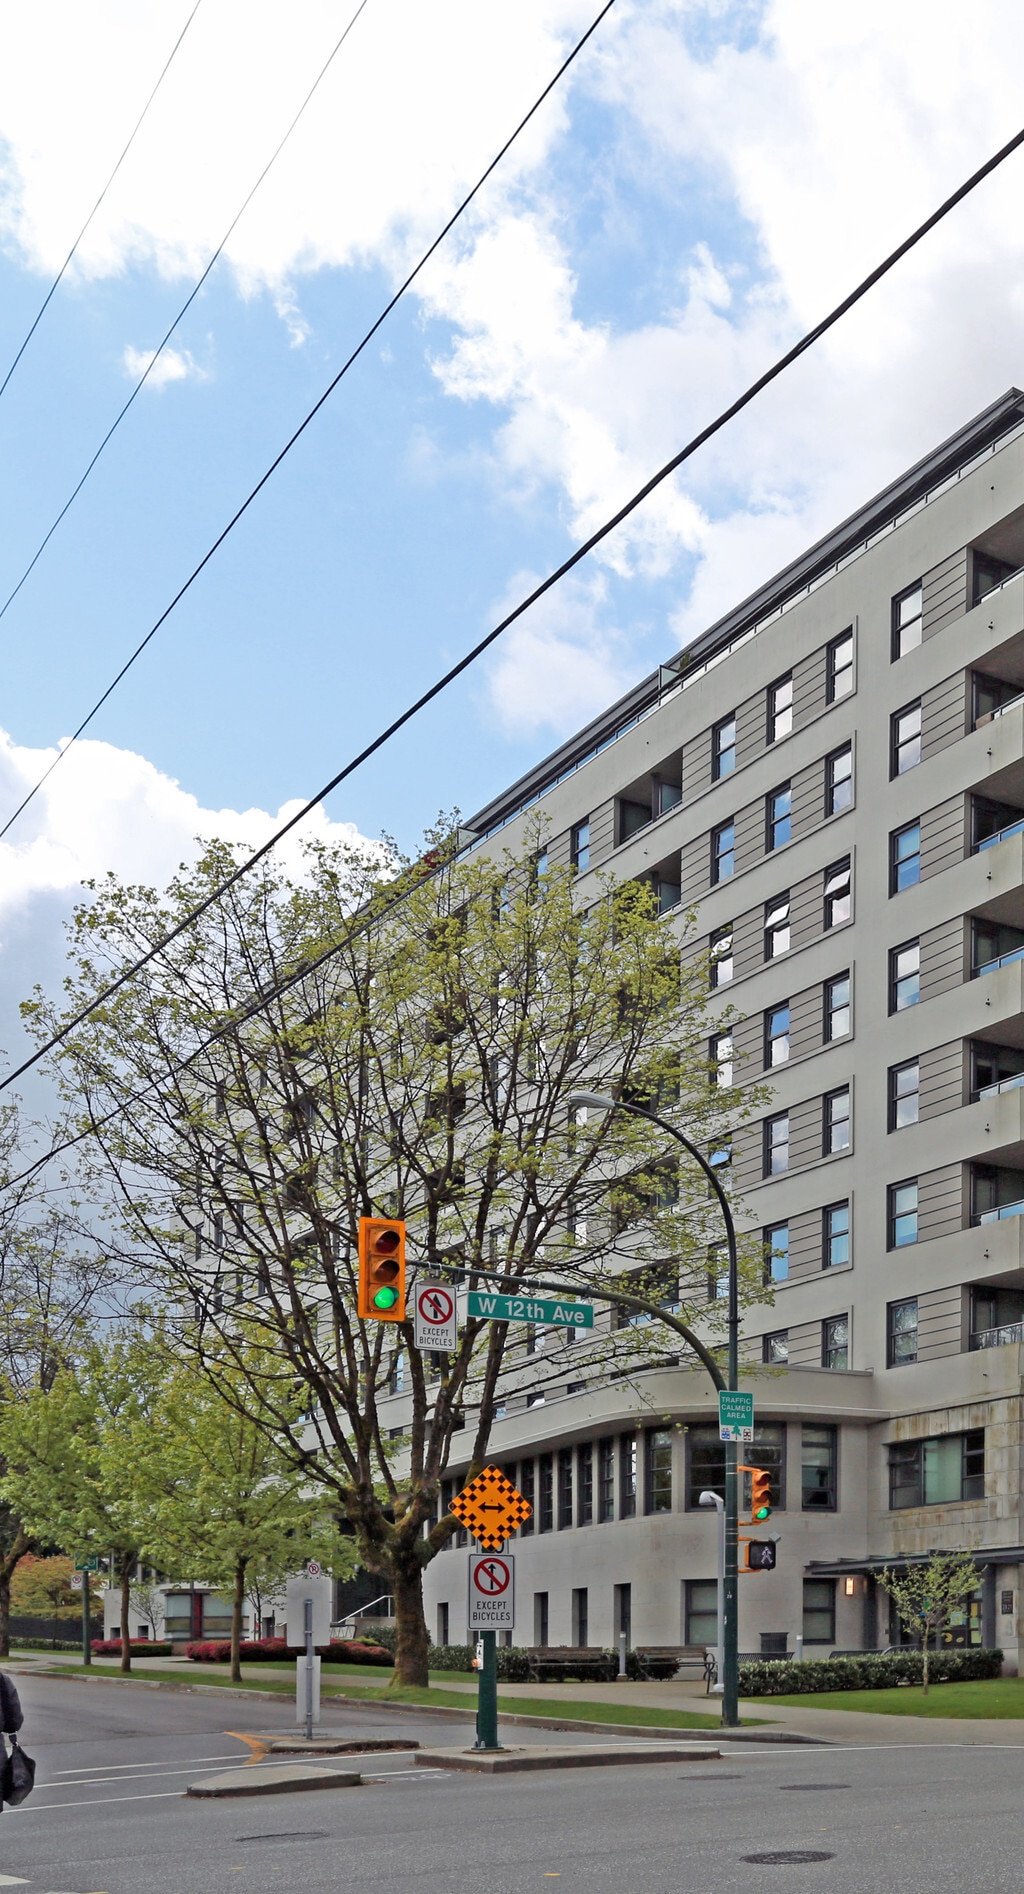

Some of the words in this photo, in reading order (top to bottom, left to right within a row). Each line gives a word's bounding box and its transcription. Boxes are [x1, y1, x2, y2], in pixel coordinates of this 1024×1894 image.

[478, 1297, 496, 1314] W
[505, 1299, 544, 1320] 12th
[552, 1305, 585, 1324] Ave
[422, 1327, 449, 1337] EXCEPT
[419, 1337, 452, 1347] BICYCLES
[721, 1396, 751, 1404] TRAFFIC
[721, 1404, 751, 1412] CALMED
[476, 1601, 507, 1610] EXCEPT
[472, 1611, 511, 1621] BICYCLES
